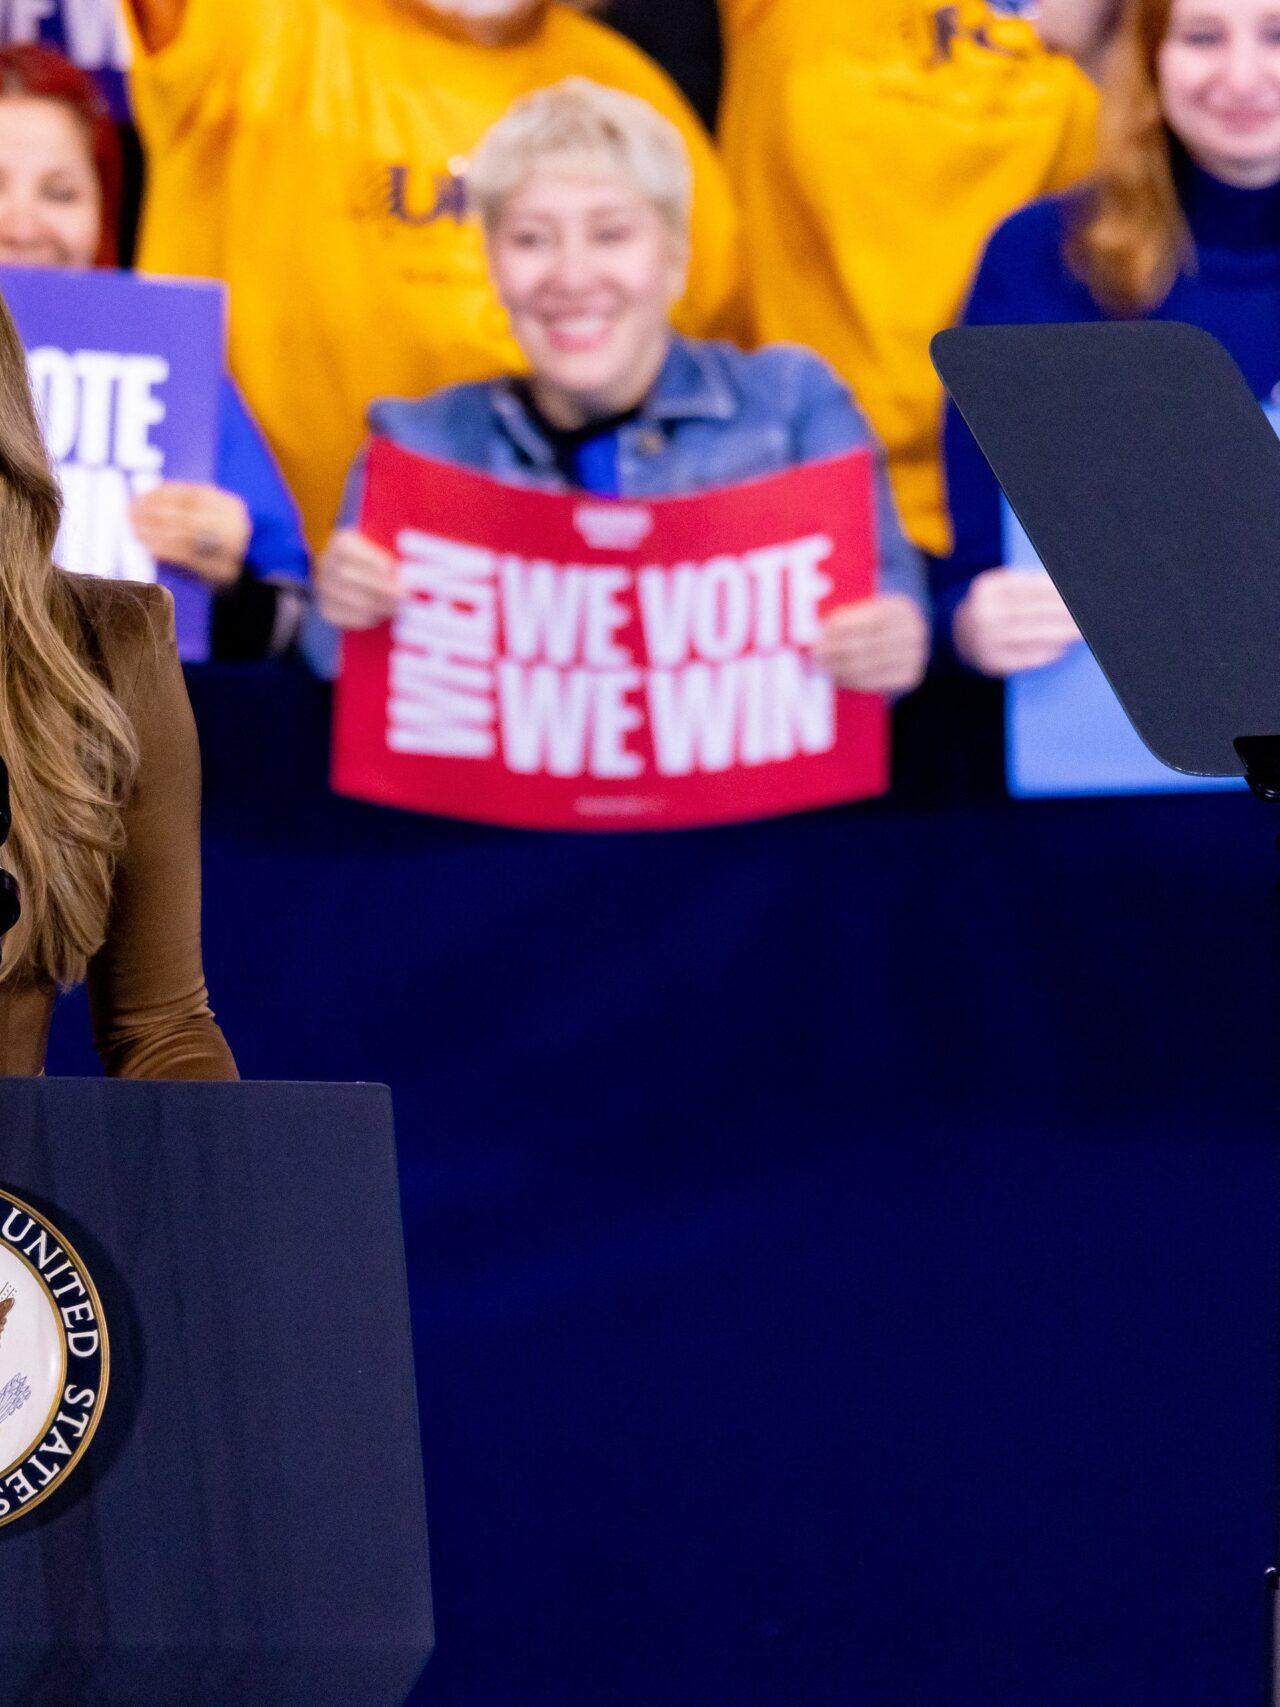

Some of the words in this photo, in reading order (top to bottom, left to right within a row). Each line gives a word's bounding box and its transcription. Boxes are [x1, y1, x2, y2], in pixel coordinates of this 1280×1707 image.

[26, 346, 170, 471] OTE
[499, 553, 634, 672] WE
[635, 532, 835, 670] VOTE
[500, 660, 645, 780] WE
[647, 645, 837, 780] WIN
[1, 1207, 99, 1358] UNITED
